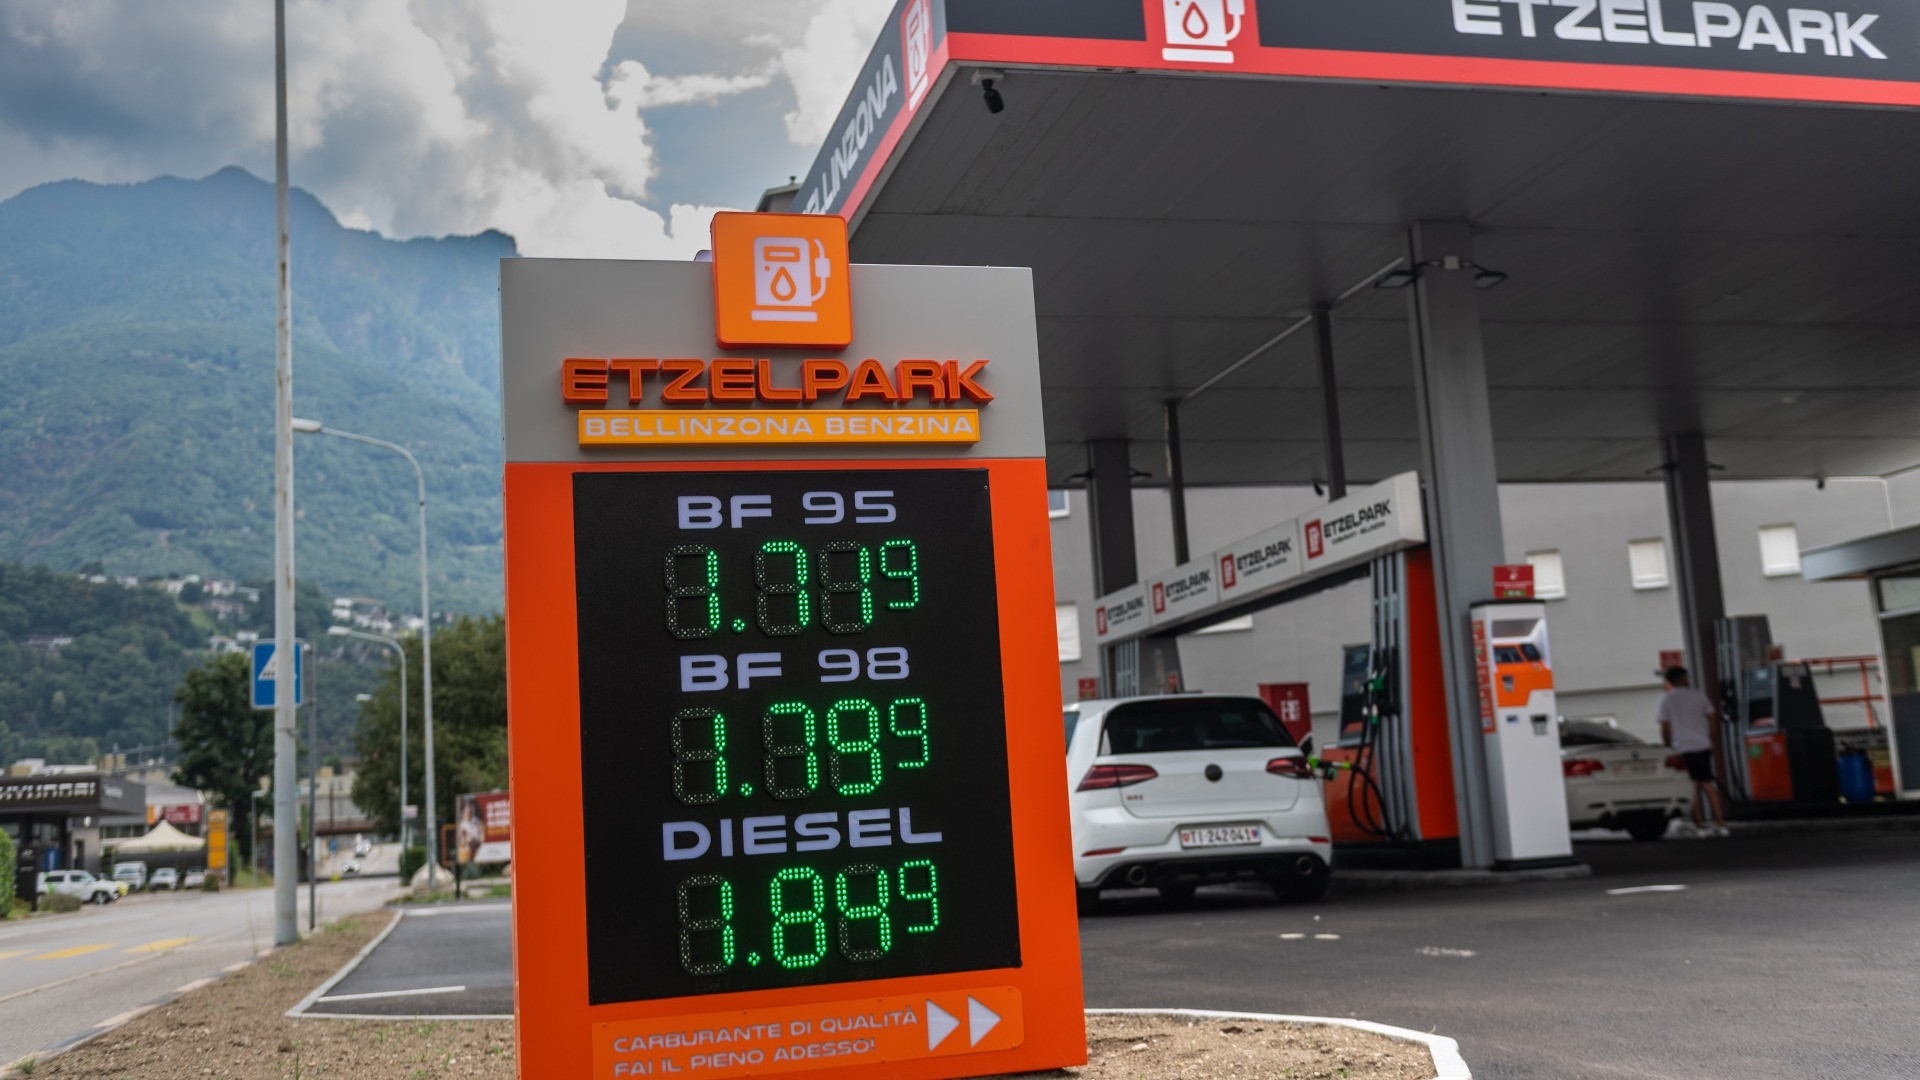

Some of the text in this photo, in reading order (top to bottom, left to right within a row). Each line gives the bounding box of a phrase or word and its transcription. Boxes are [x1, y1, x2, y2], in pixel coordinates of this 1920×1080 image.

[1452, 0, 1888, 59] ETZELPARK
[562, 358, 995, 404] ETZELPARK
[584, 415, 974, 438] BELLINZONA BENZINA
[678, 490, 897, 529] BF 95
[1324, 500, 1392, 538] ETZELPARK
[1237, 538, 1292, 571] ETZELPARK
[680, 647, 909, 692] BF 98
[662, 807, 943, 861] DIESEL
[613, 1005, 918, 1053] CARBURANTE DI QUALITÀ
[614, 1037, 876, 1078] FAI IL PIENO ADESSO!
